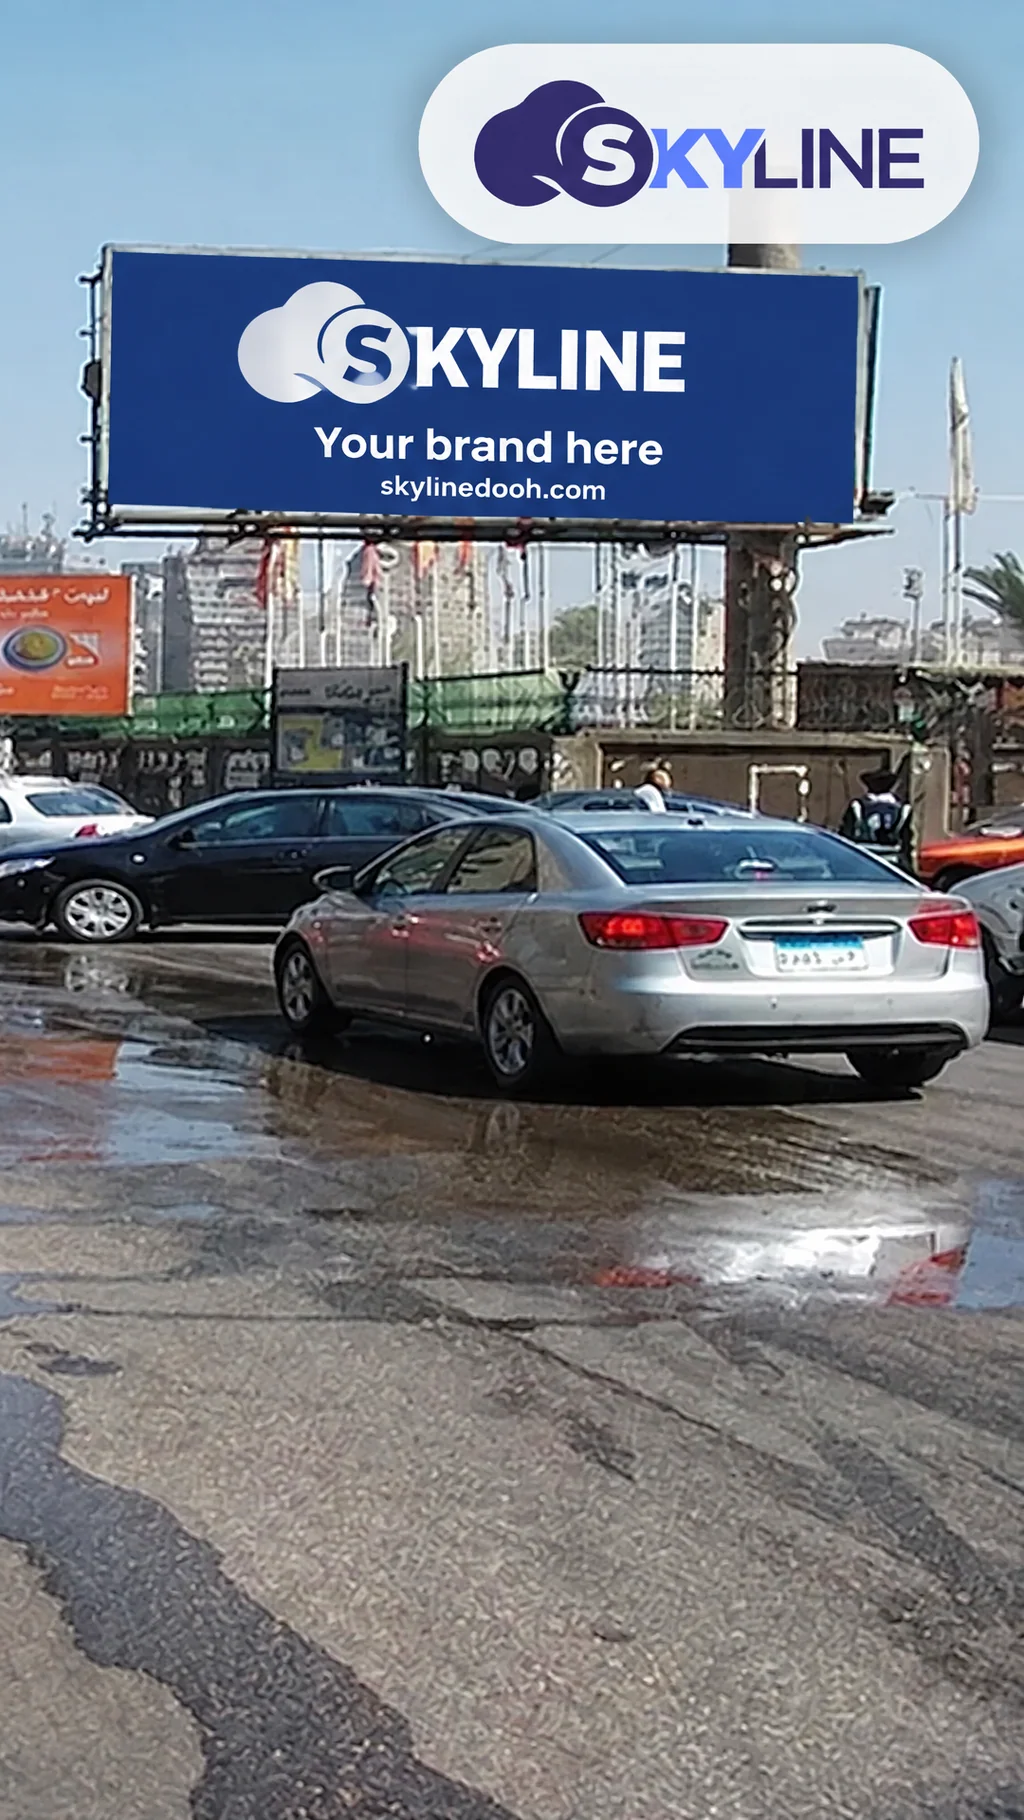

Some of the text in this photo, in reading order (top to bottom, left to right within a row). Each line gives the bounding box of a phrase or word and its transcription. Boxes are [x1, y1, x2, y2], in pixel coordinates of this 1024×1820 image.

[342, 323, 686, 393] SKYLINE
[313, 426, 664, 466] Your brand here
[379, 475, 607, 502] skylinedooh.com
